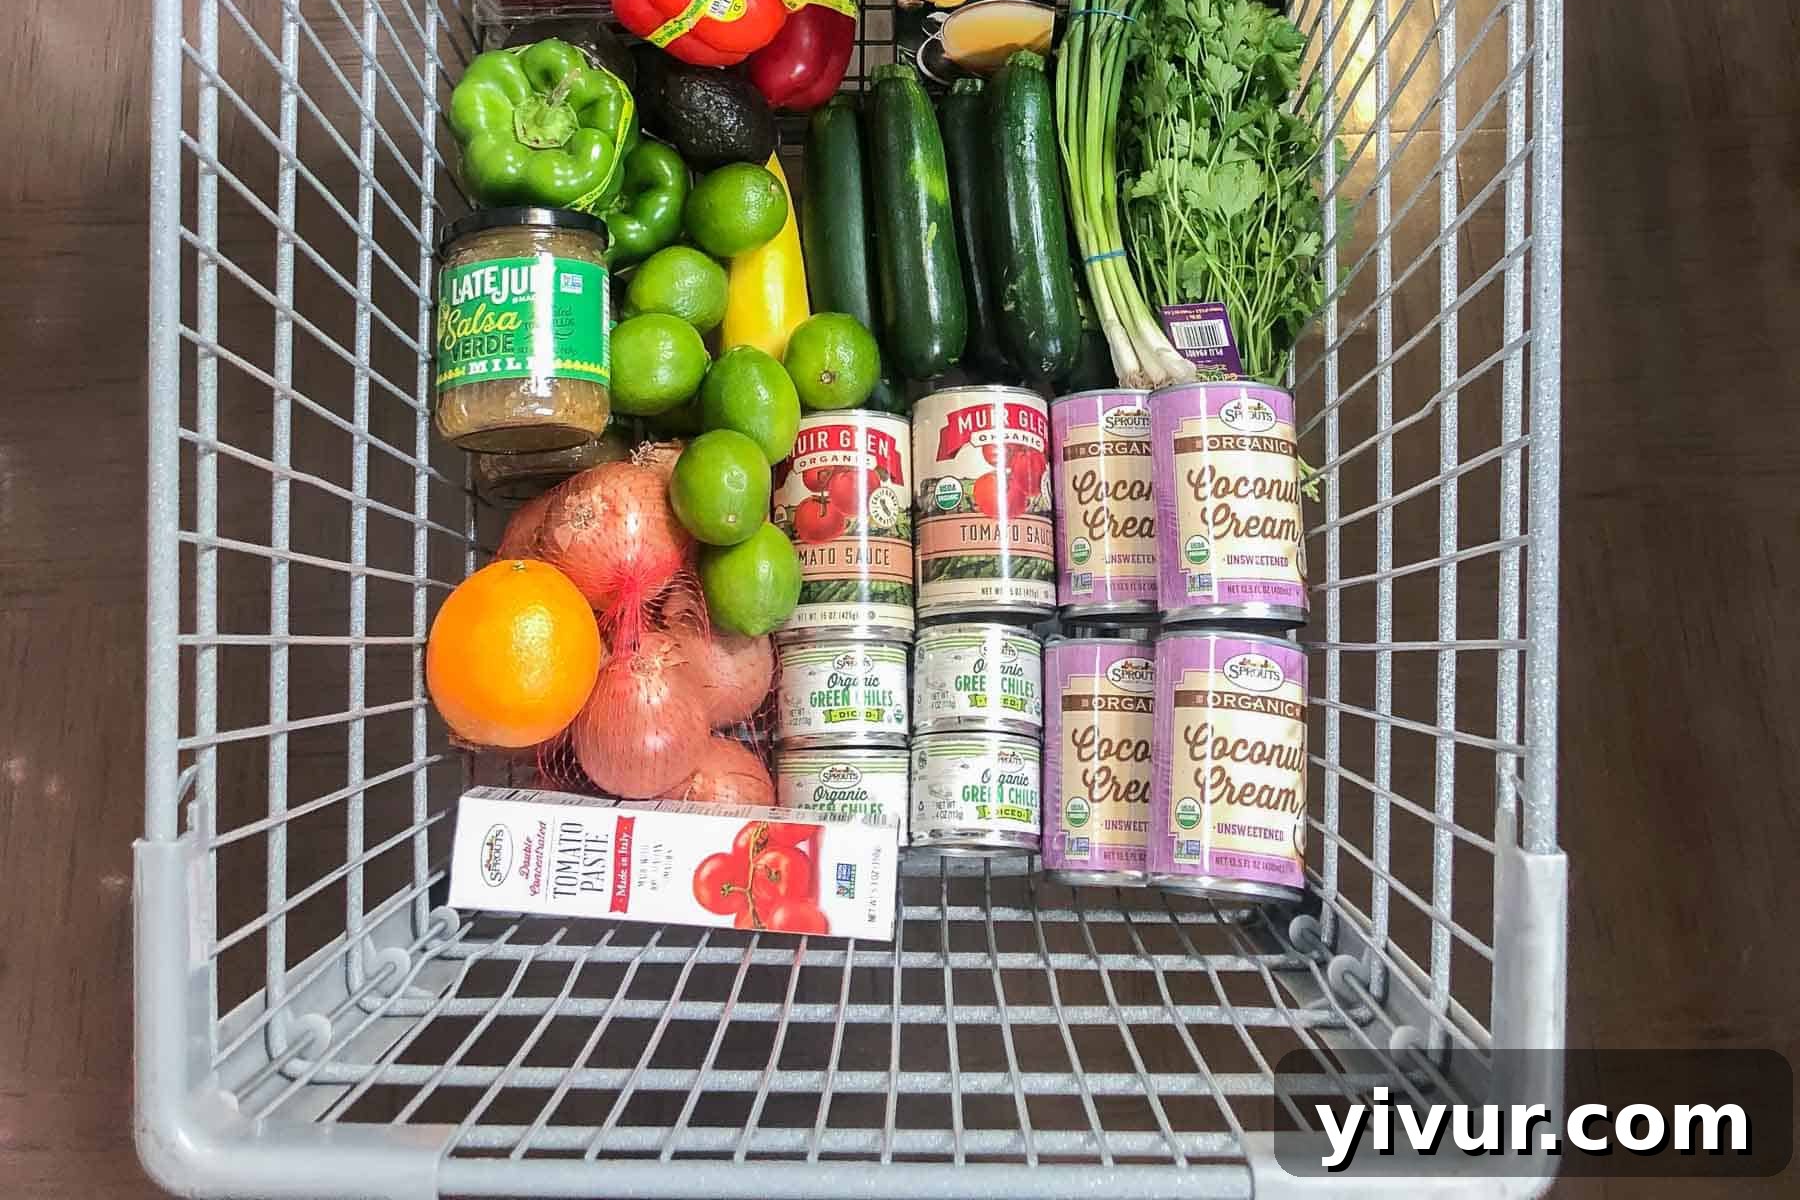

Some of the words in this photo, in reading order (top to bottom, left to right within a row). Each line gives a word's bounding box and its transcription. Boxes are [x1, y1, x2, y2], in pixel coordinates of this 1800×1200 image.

[453, 266, 501, 306] LATE
[491, 263, 557, 304] JU
[445, 303, 521, 350] Salsa
[450, 333, 514, 363] VERDE
[839, 431, 889, 457] GEN
[979, 432, 1042, 448] OGANIC
[1088, 442, 1152, 456] ORGAN
[1207, 436, 1287, 453] ORGANIC
[799, 454, 872, 468] ORGANI
[1072, 469, 1153, 505] Coco
[1187, 464, 1299, 504] Coconut
[1083, 502, 1156, 541] Crea
[1201, 502, 1299, 542] Cream
[960, 525, 1019, 542] TOMAO
[1026, 526, 1052, 545] SAUC
[799, 549, 836, 567] MATO
[1105, 553, 1155, 565] NSWEETE
[1226, 555, 1289, 567] UNSWEETENED
[1227, 584, 1239, 594] NET
[827, 673, 880, 692] Orgic
[1112, 669, 1154, 682] SPROUT
[1229, 664, 1281, 682] SPROUTS
[955, 675, 988, 693] GREE
[1001, 678, 1035, 699] CHILES
[810, 689, 850, 708] GREEN
[1092, 697, 1154, 712] ORGA
[1207, 695, 1296, 717] ORGANIC
[839, 711, 872, 719] DICD
[1072, 725, 1151, 762] Coco
[1184, 722, 1304, 772] Coconut
[981, 768, 1030, 787] Oganic
[813, 785, 869, 806] Organic
[1009, 787, 1038, 809] CHILE
[1194, 765, 1300, 814] Cream
[994, 808, 1026, 818] ICED
[1104, 820, 1148, 833] UNSWEET
[1217, 822, 1284, 842] UNSWEETENED
[618, 830, 632, 856] Italy
[489, 828, 505, 882] SPROUTS
[519, 835, 534, 881] Double
[529, 820, 548, 898] Concentrated
[552, 821, 585, 901] TOMATO
[580, 832, 610, 893] PASTE
[615, 867, 627, 897] Made
